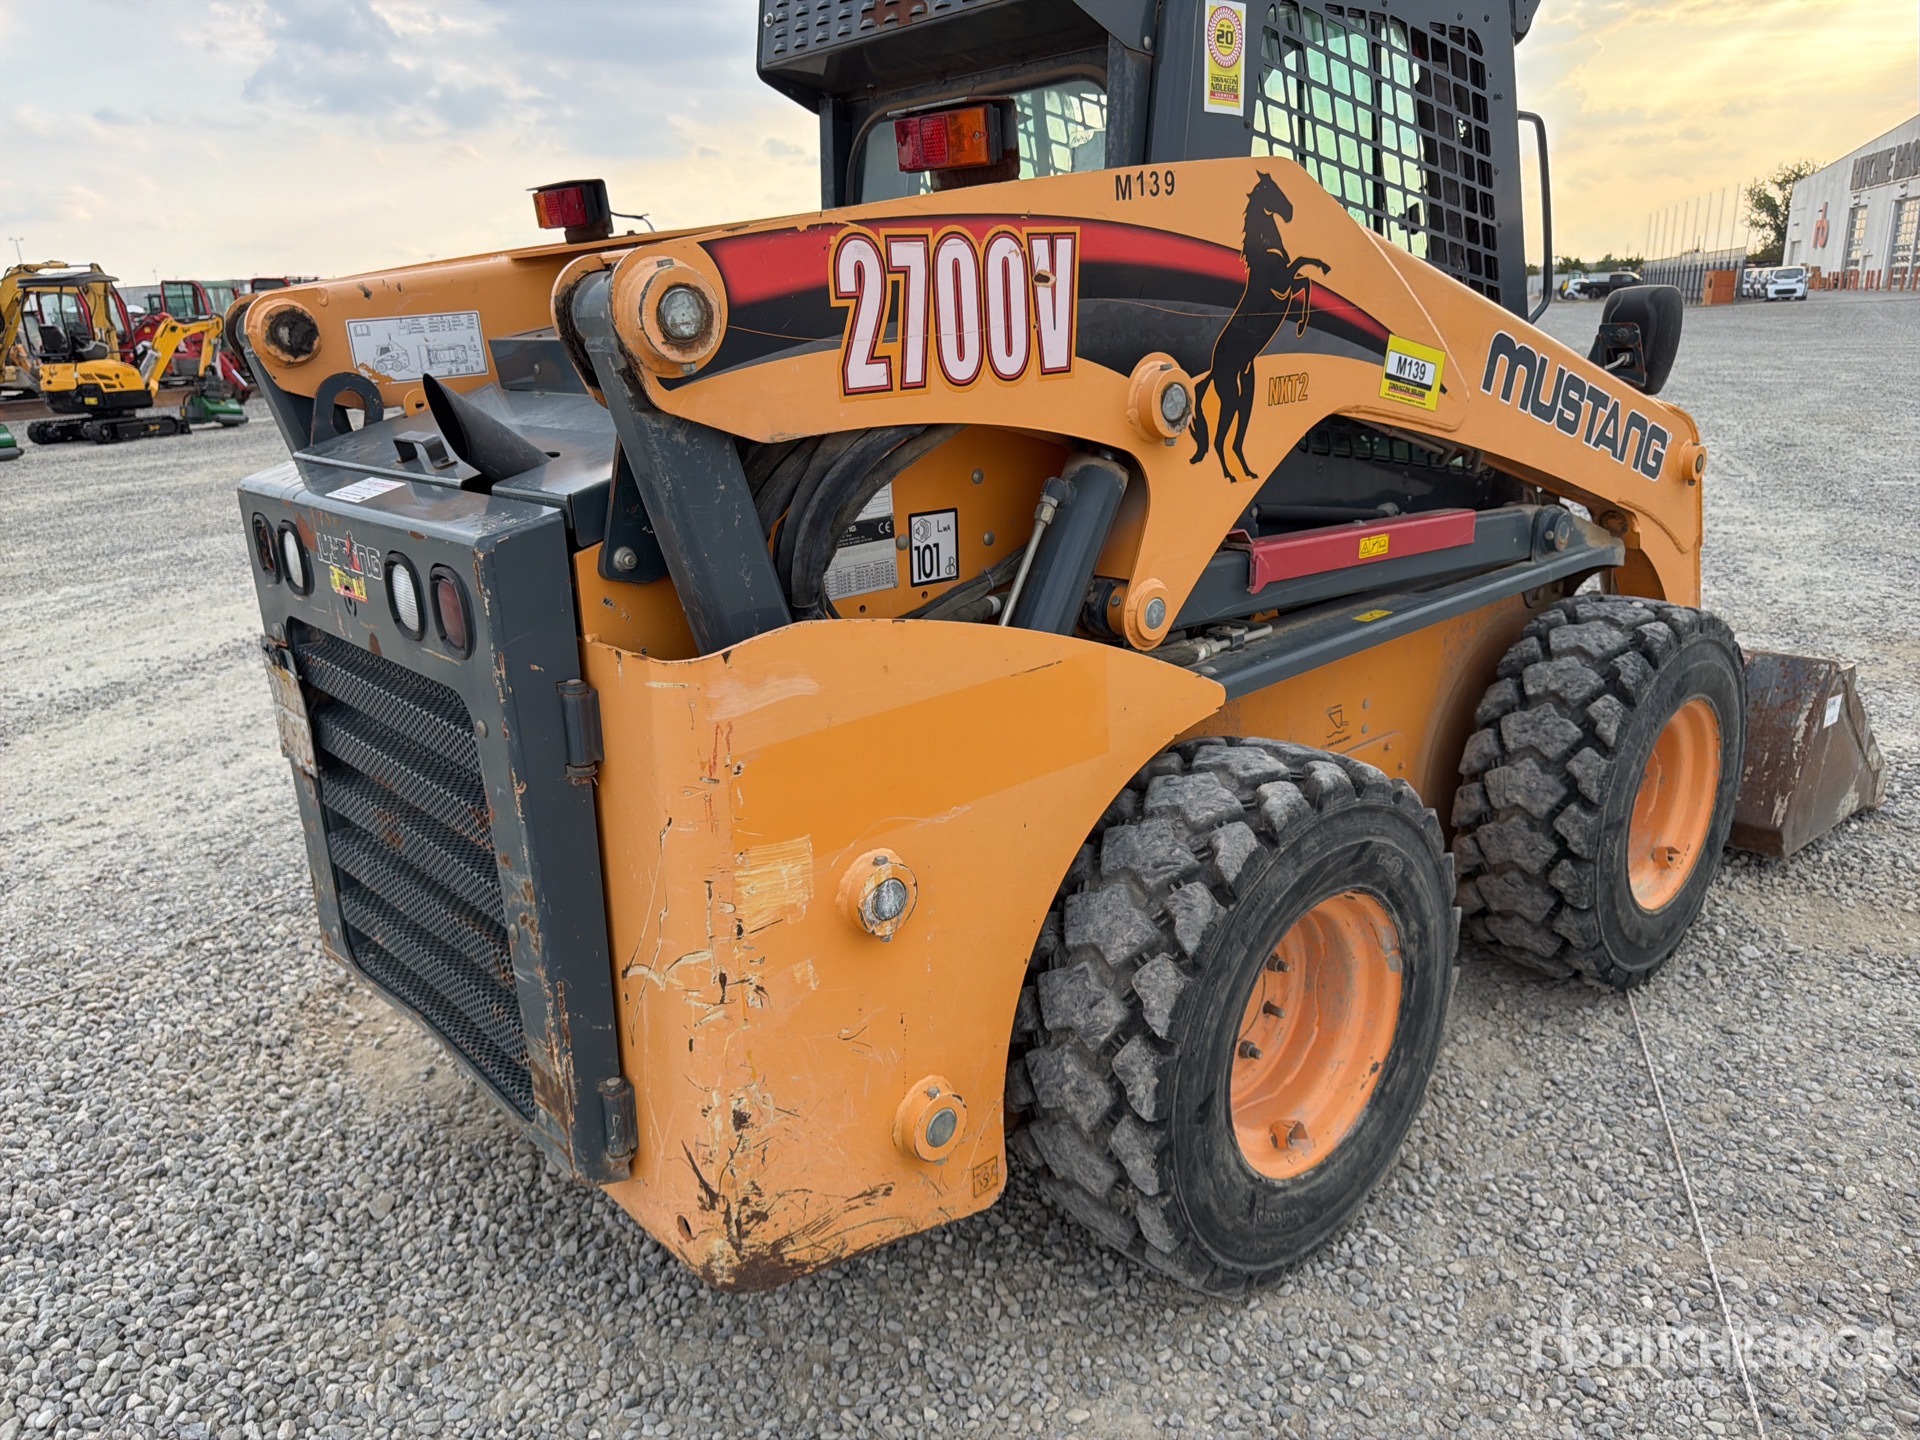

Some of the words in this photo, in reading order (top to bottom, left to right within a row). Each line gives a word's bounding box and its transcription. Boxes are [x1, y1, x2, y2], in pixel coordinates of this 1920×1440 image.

[1216, 29, 1234, 45] 20
[1115, 170, 1176, 201] M139
[832, 228, 1078, 398] 2700V
[1395, 356, 1427, 381] M139
[1267, 372, 1309, 407] NXT2
[1480, 330, 1669, 482] MUSTANG
[914, 542, 941, 580] 101
